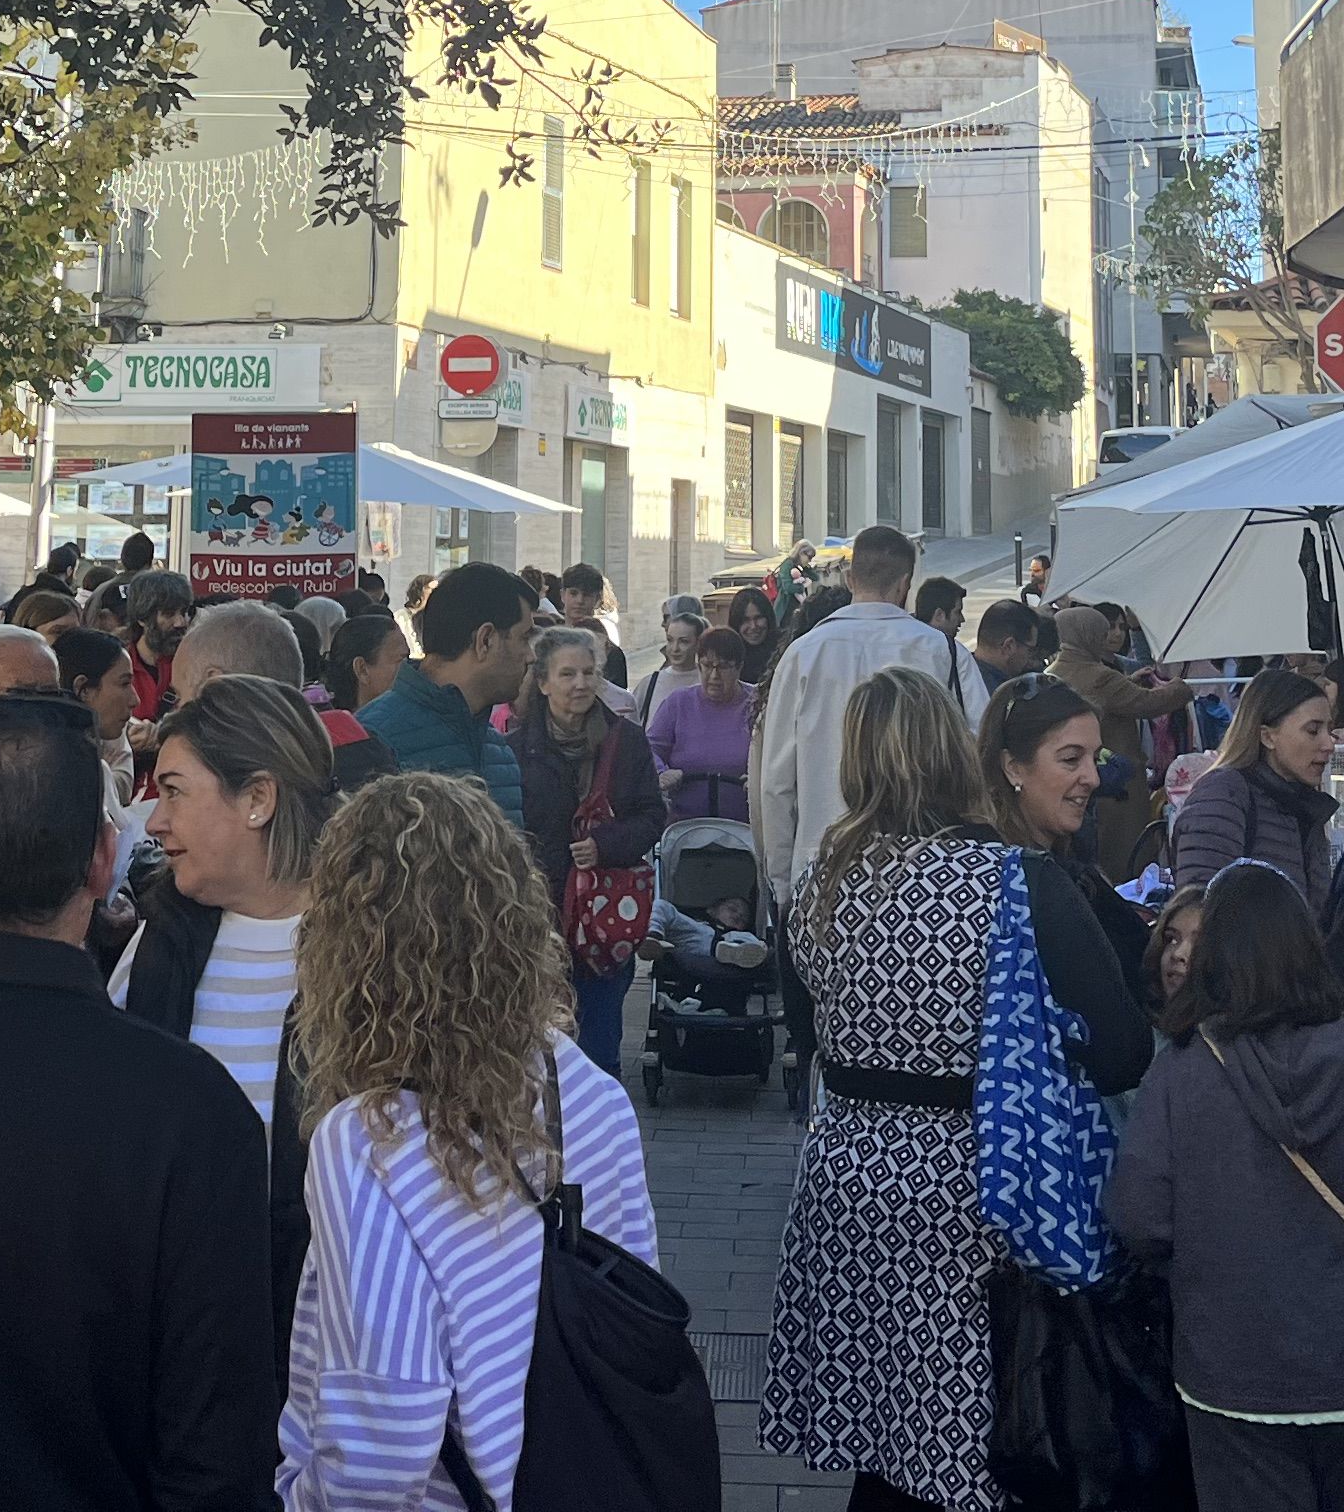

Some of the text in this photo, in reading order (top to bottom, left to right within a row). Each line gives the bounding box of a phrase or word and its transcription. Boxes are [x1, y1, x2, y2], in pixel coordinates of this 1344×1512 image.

[125, 355, 271, 388] TECNOCASA
[590, 397, 627, 431] TECNOCASA
[252, 424, 264, 432] de
[267, 424, 310, 432] vianants
[213, 558, 333, 576] Viu la ciutat
[304, 579, 337, 593] Rubí
